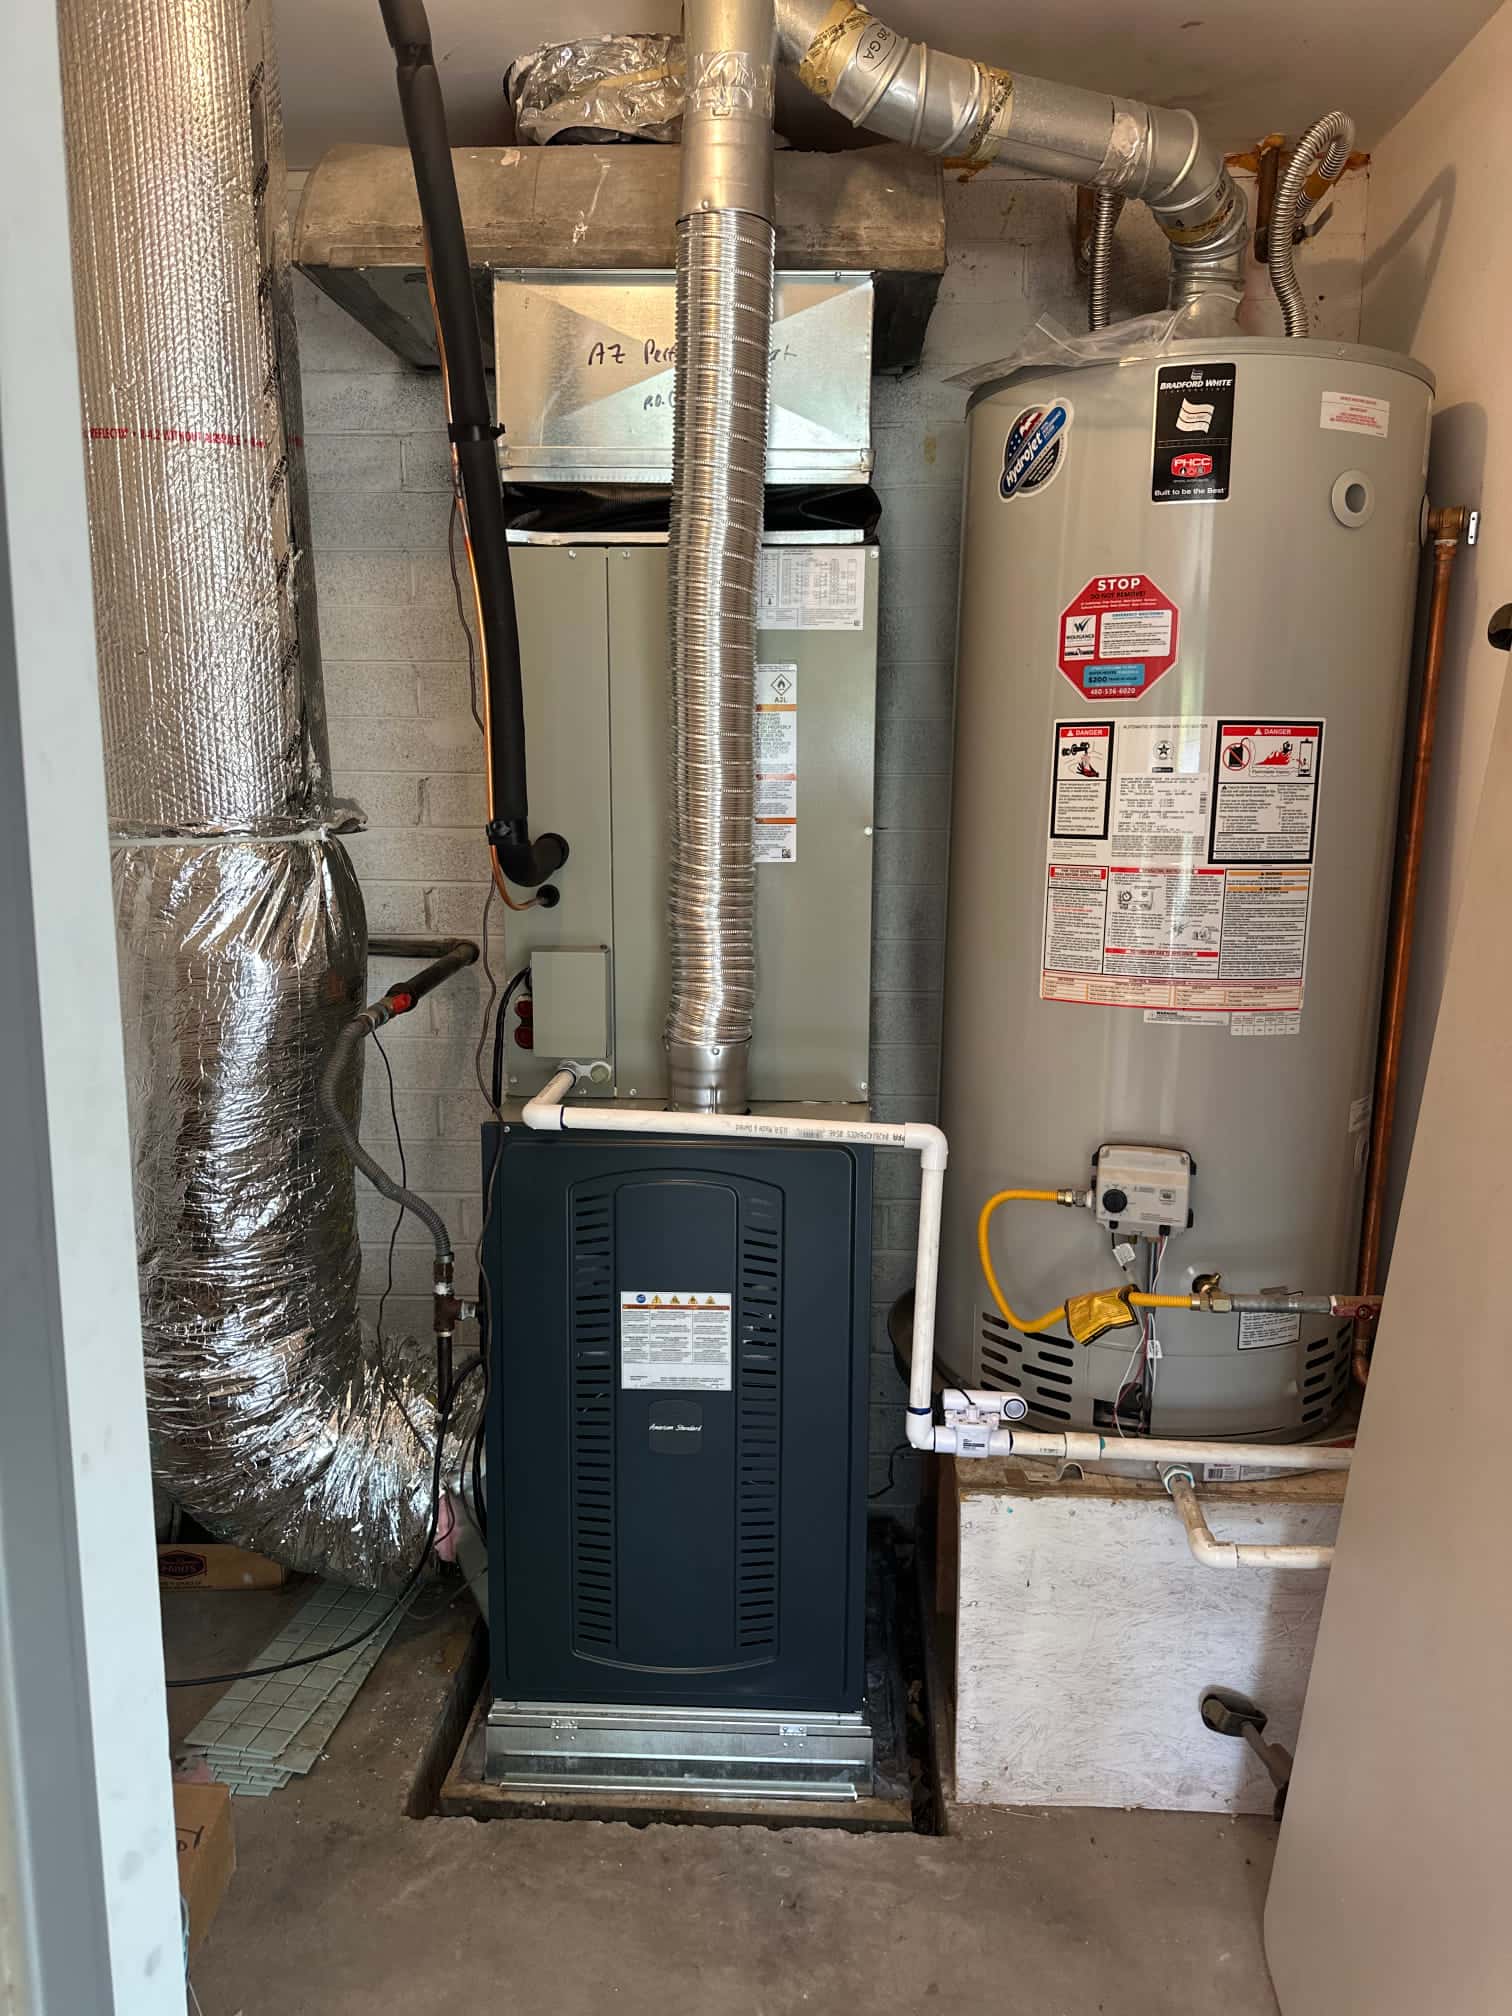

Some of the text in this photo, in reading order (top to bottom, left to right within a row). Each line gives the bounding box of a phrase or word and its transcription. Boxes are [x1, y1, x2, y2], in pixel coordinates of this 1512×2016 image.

[863, 40, 882, 60] GA
[588, 342, 626, 366] AZ
[1159, 380, 1204, 390] BRADFORD
[1205, 378, 1233, 387] WHITE
[1006, 431, 1043, 488] Hydrojet
[1173, 457, 1211, 467] PHCC
[1154, 486, 1225, 497] Built to be the Best
[1097, 577, 1141, 592] STOP
[1075, 728, 1103, 737] DANGER
[1263, 727, 1292, 736] DANGER
